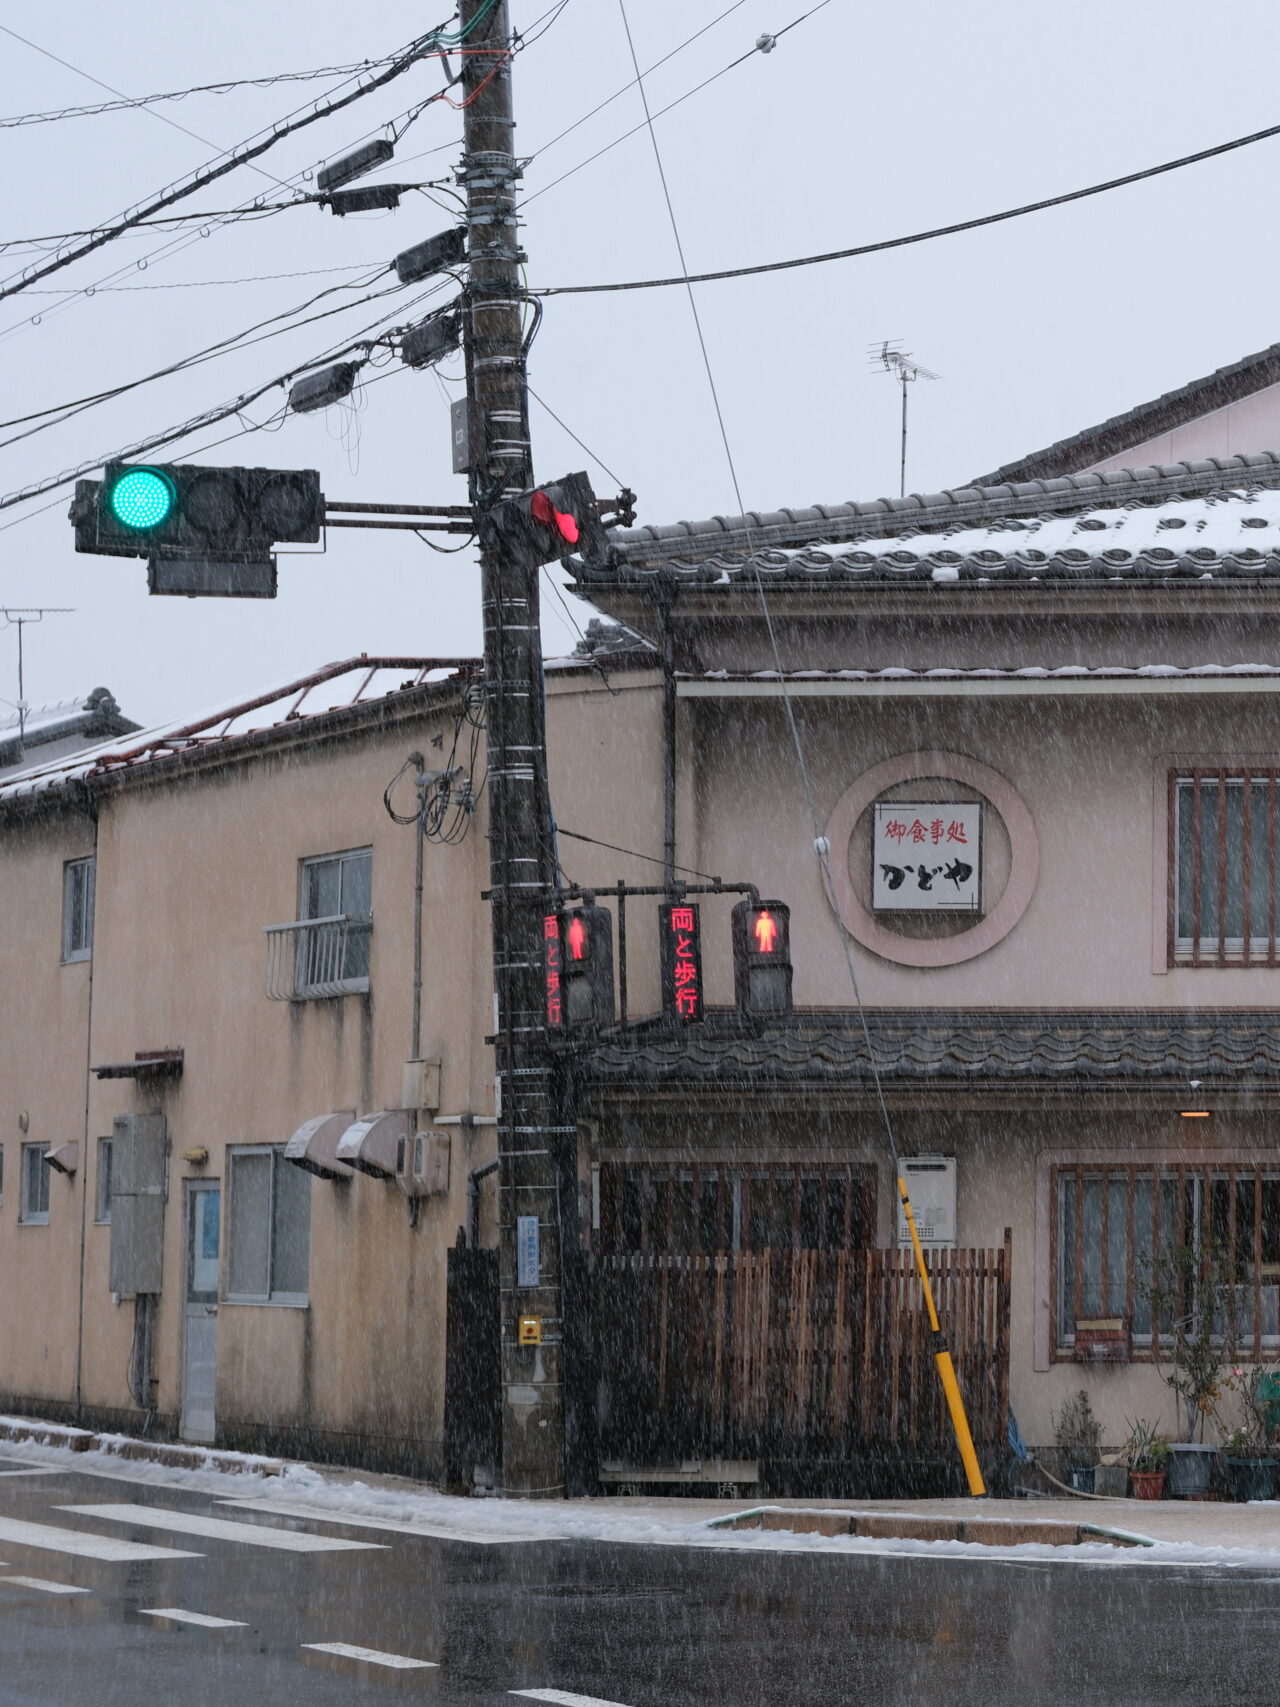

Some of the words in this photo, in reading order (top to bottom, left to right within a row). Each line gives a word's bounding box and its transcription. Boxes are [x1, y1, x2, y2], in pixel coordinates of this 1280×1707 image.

[884, 818, 969, 846] 御食事処
[879, 857, 974, 892] かどや
[543, 914, 562, 1023] 両と歩行
[670, 907, 698, 1015] 両と歩行
